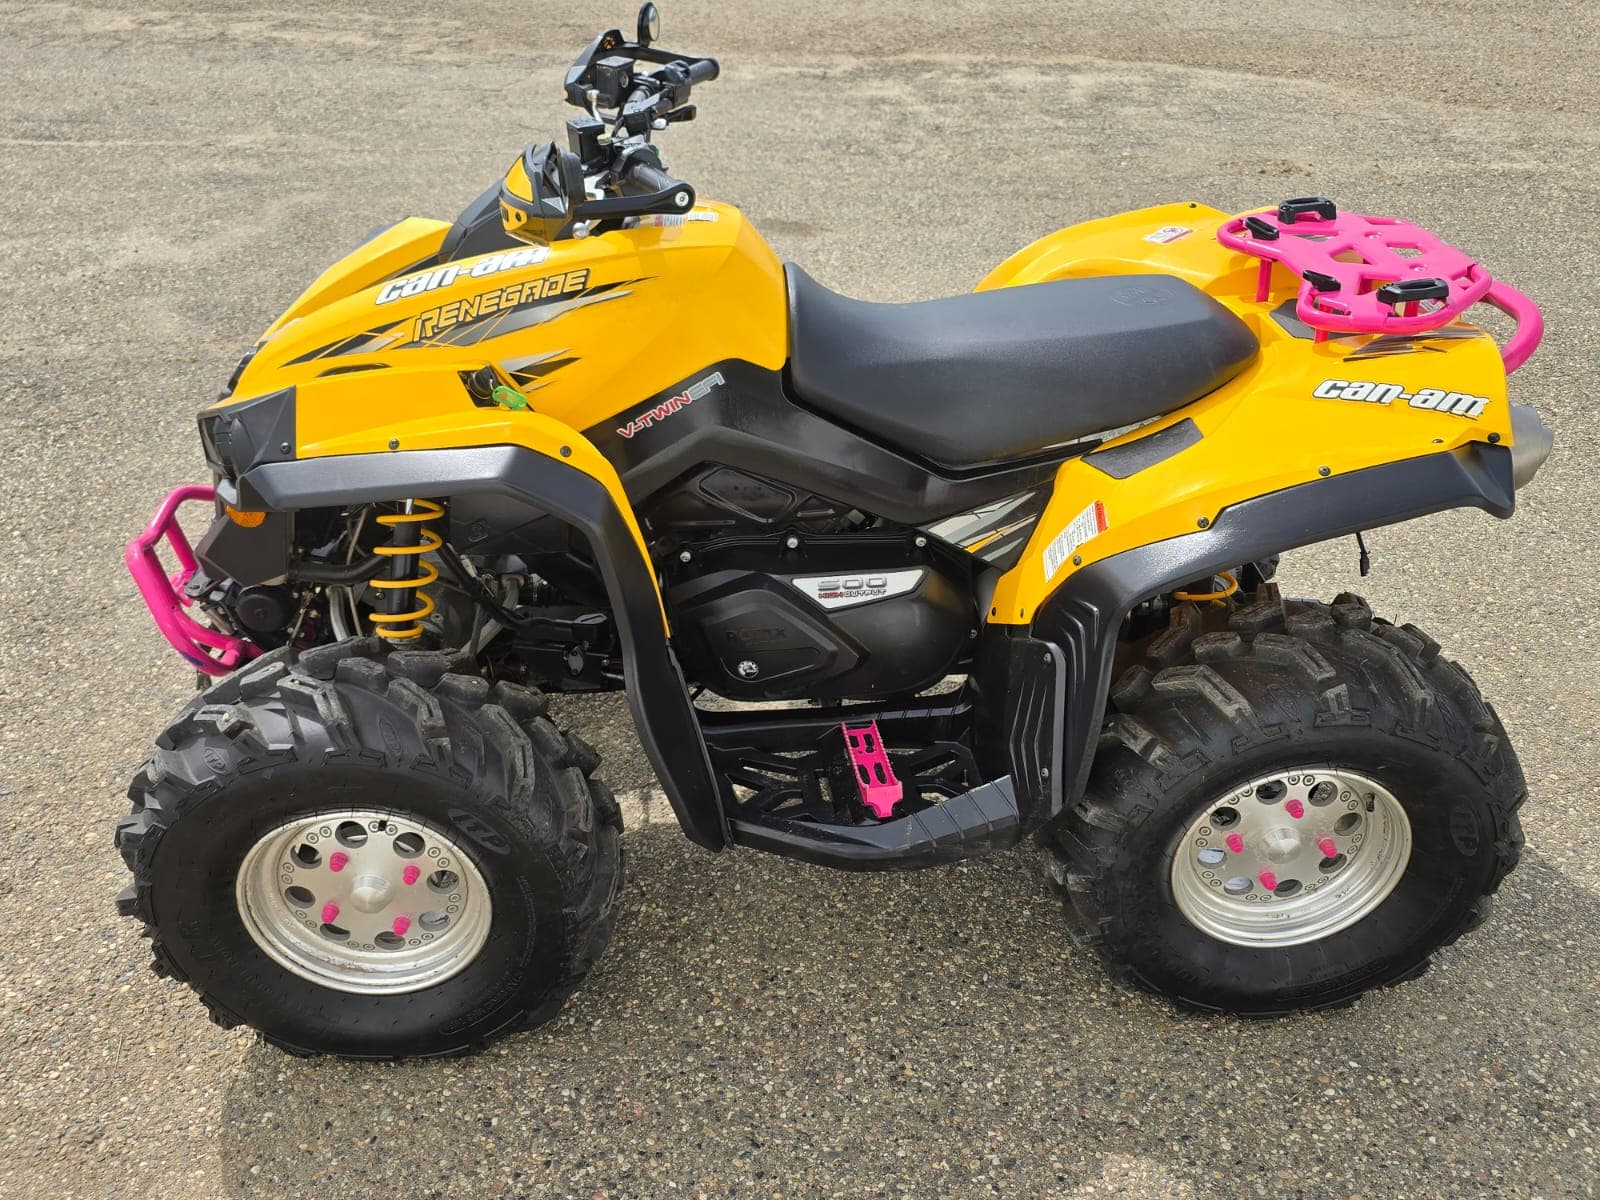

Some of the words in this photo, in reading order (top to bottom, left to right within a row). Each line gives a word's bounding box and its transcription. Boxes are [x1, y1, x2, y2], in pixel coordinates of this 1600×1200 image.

[376, 247, 550, 305] can-am
[413, 269, 590, 342] RENEGADE
[616, 390, 693, 438] V-TWIN
[1312, 379, 1491, 419] can-am
[817, 576, 888, 591] 500
[204, 748, 227, 771] ITP
[448, 808, 509, 854] ITP
